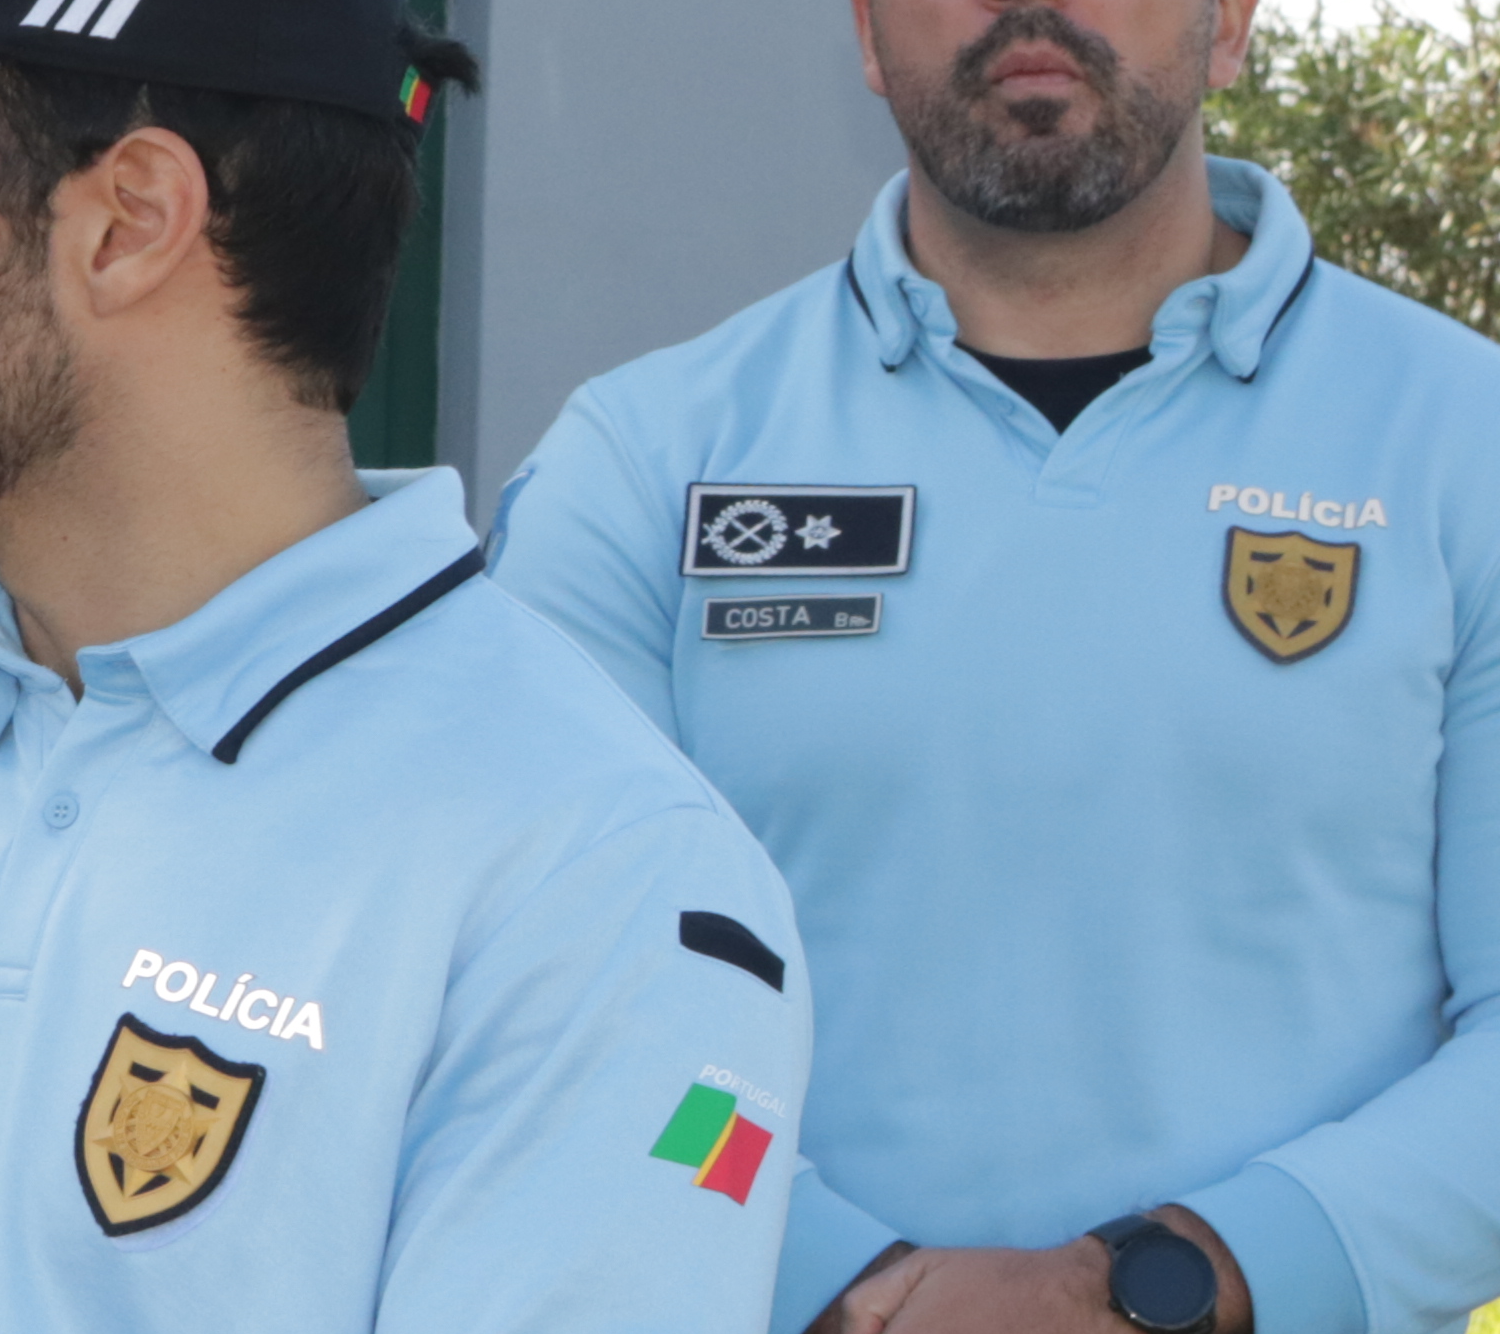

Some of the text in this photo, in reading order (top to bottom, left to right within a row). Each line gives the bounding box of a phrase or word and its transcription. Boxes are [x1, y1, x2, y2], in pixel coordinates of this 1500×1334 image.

[1207, 483, 1388, 529] POLÍCIA
[725, 605, 811, 629] COSTA
[121, 948, 324, 1050] POLÍCIA
[698, 1064, 786, 1118] PORTUGAL
